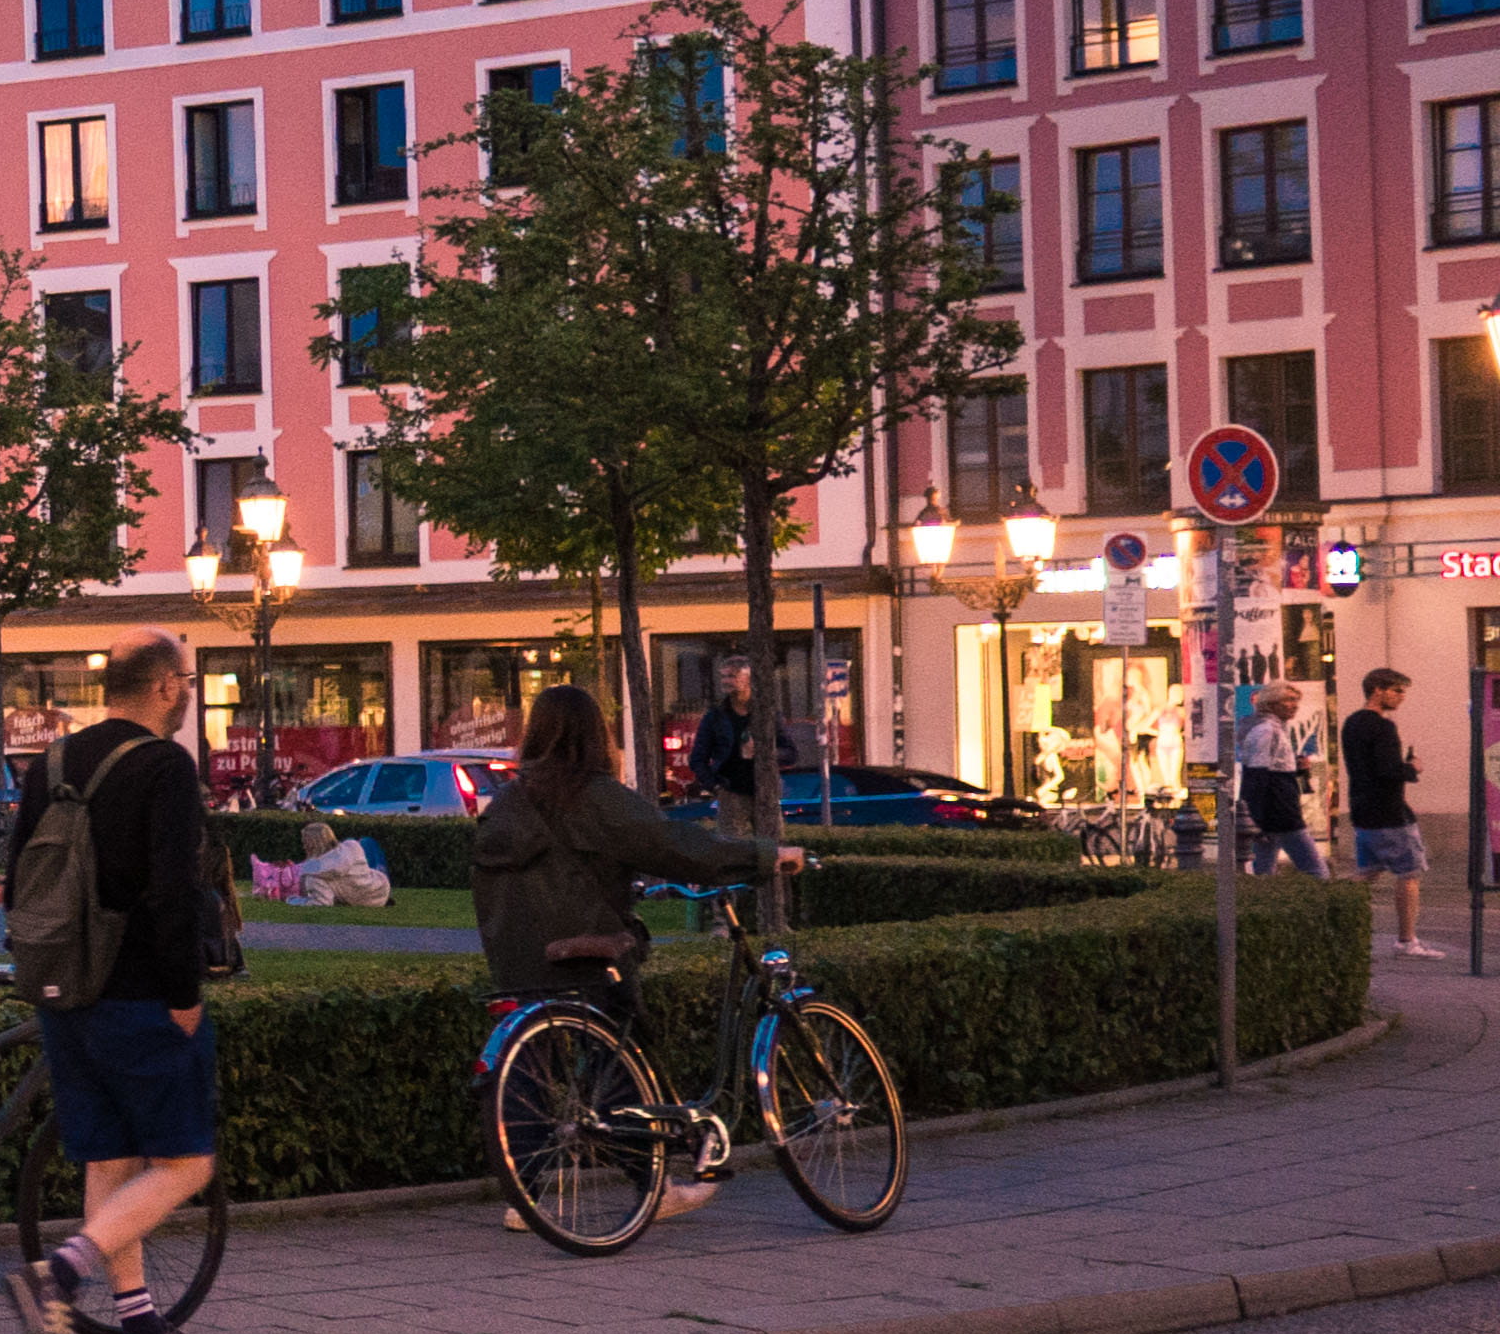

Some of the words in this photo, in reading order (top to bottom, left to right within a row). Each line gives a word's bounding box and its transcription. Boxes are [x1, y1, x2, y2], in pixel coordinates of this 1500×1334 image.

[13, 714, 45, 728] frisch
[216, 758, 237, 770] zu
[240, 754, 293, 771] Peny
